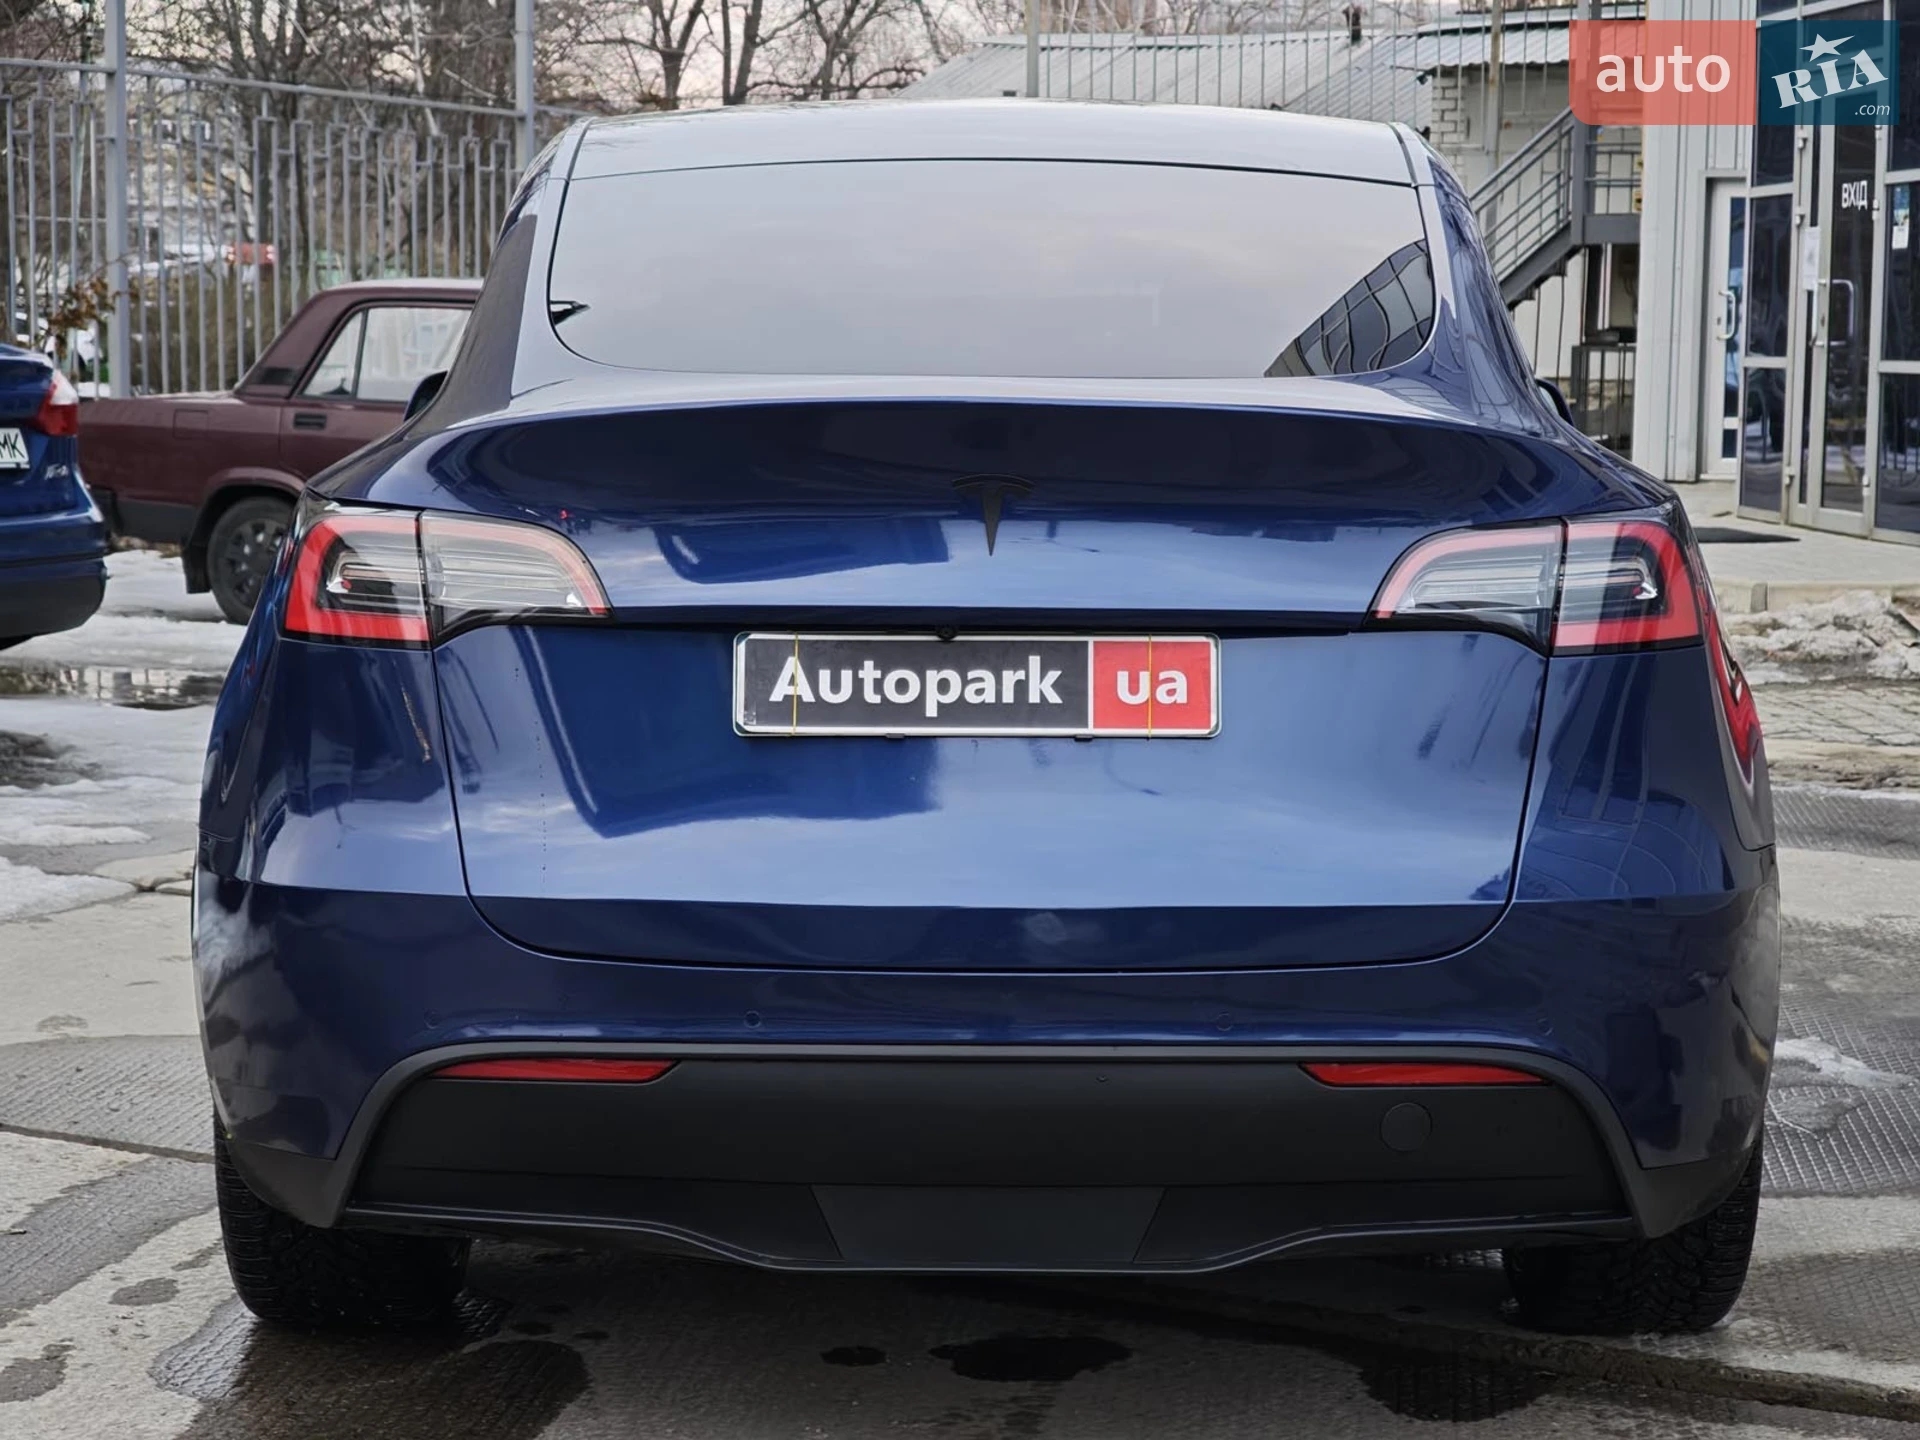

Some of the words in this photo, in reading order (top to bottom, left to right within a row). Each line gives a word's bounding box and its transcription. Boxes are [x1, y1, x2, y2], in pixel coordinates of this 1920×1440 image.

[1841, 180, 1867, 210] ВХІД
[768, 655, 1063, 717] Autopark
[1116, 669, 1188, 704] ua
